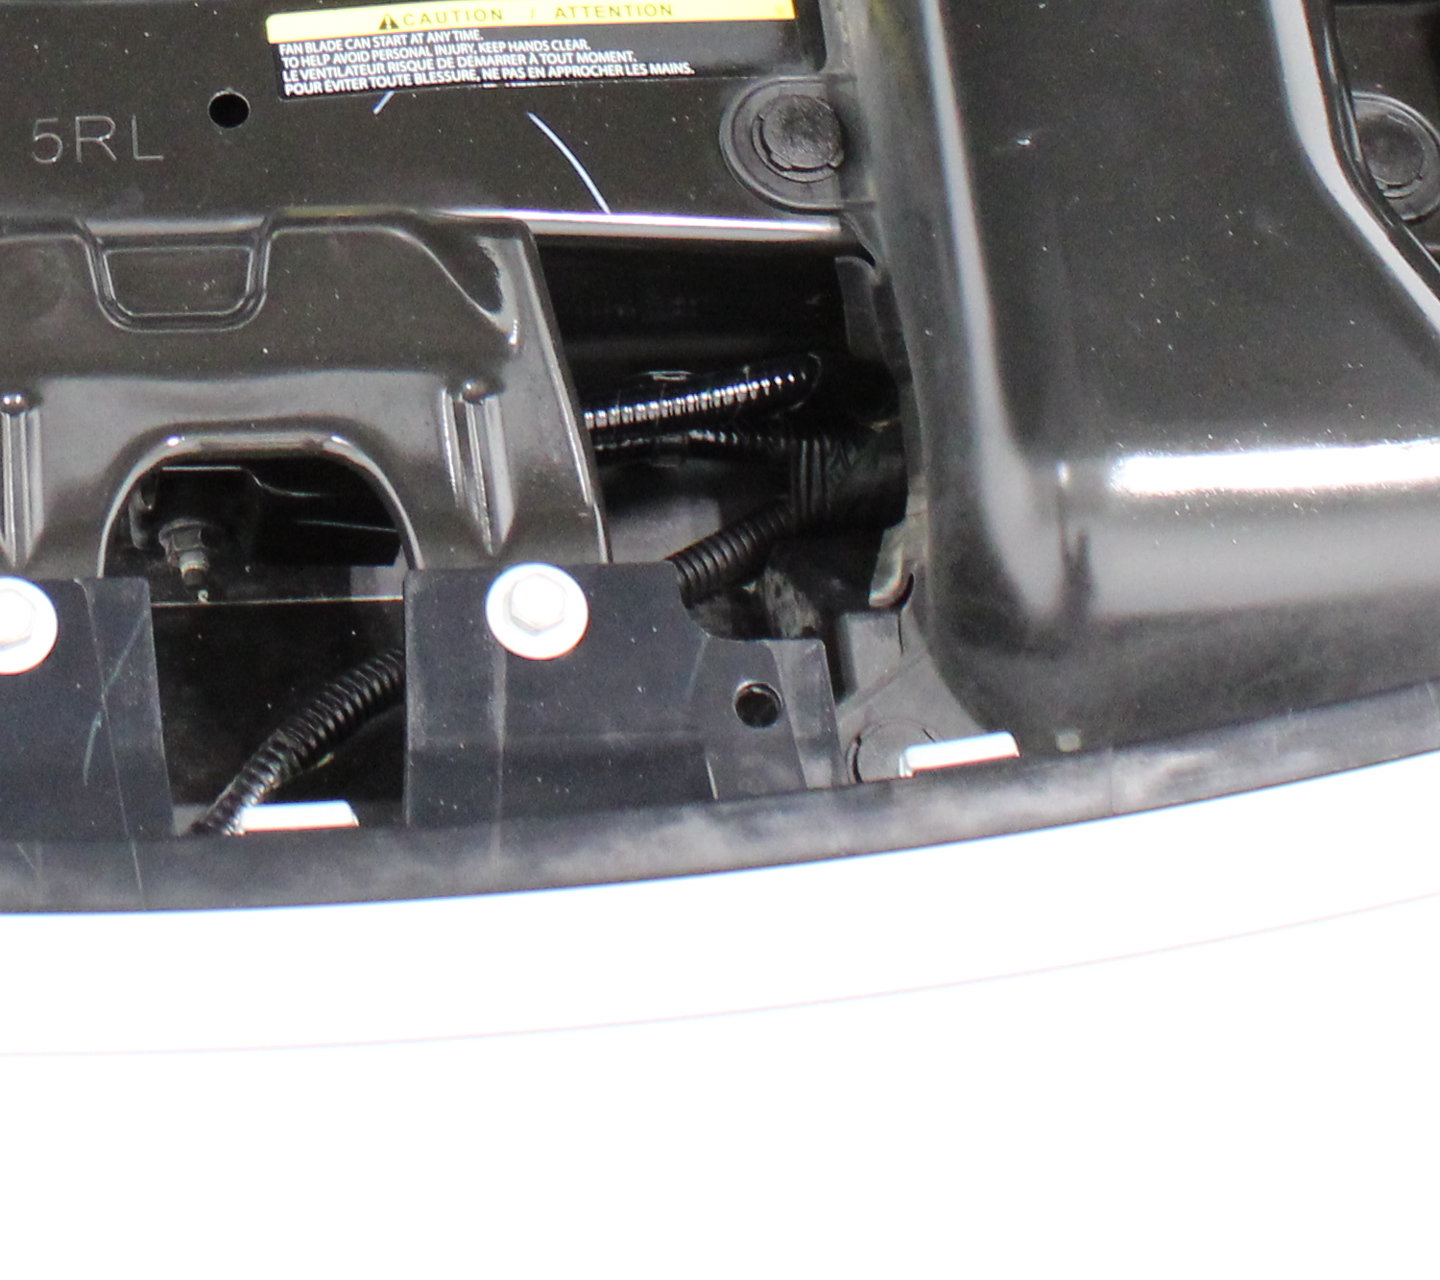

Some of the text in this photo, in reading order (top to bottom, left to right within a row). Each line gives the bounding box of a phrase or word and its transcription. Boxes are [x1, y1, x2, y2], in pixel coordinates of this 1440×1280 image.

[402, 7, 504, 28] CAUTION
[554, 2, 674, 20] ATTENTION
[279, 28, 485, 56] FAN BLADE CAN START AT ANY TIME.
[281, 38, 592, 70] TO HELP AVOID PERSONAL INJURY, KEEP HANDS CLEAR.
[283, 69, 299, 84] LE
[300, 62, 386, 82] VENTILATEUR
[386, 58, 435, 76] RISQUE
[436, 55, 455, 70] DE
[540, 51, 575, 66] TOUT
[576, 49, 638, 64] MOMENT.
[284, 81, 323, 97] POUR
[324, 76, 368, 95] ÉVITER
[368, 73, 412, 90] TOUTE
[412, 68, 481, 87] BLESSURE,
[481, 67, 502, 83] NE
[502, 66, 526, 81] PAS
[527, 65, 547, 80] EN
[547, 63, 625, 80] APPROCHER
[624, 62, 649, 77] LES
[649, 60, 696, 75] MAINS.
[31, 114, 165, 164] 5RL
